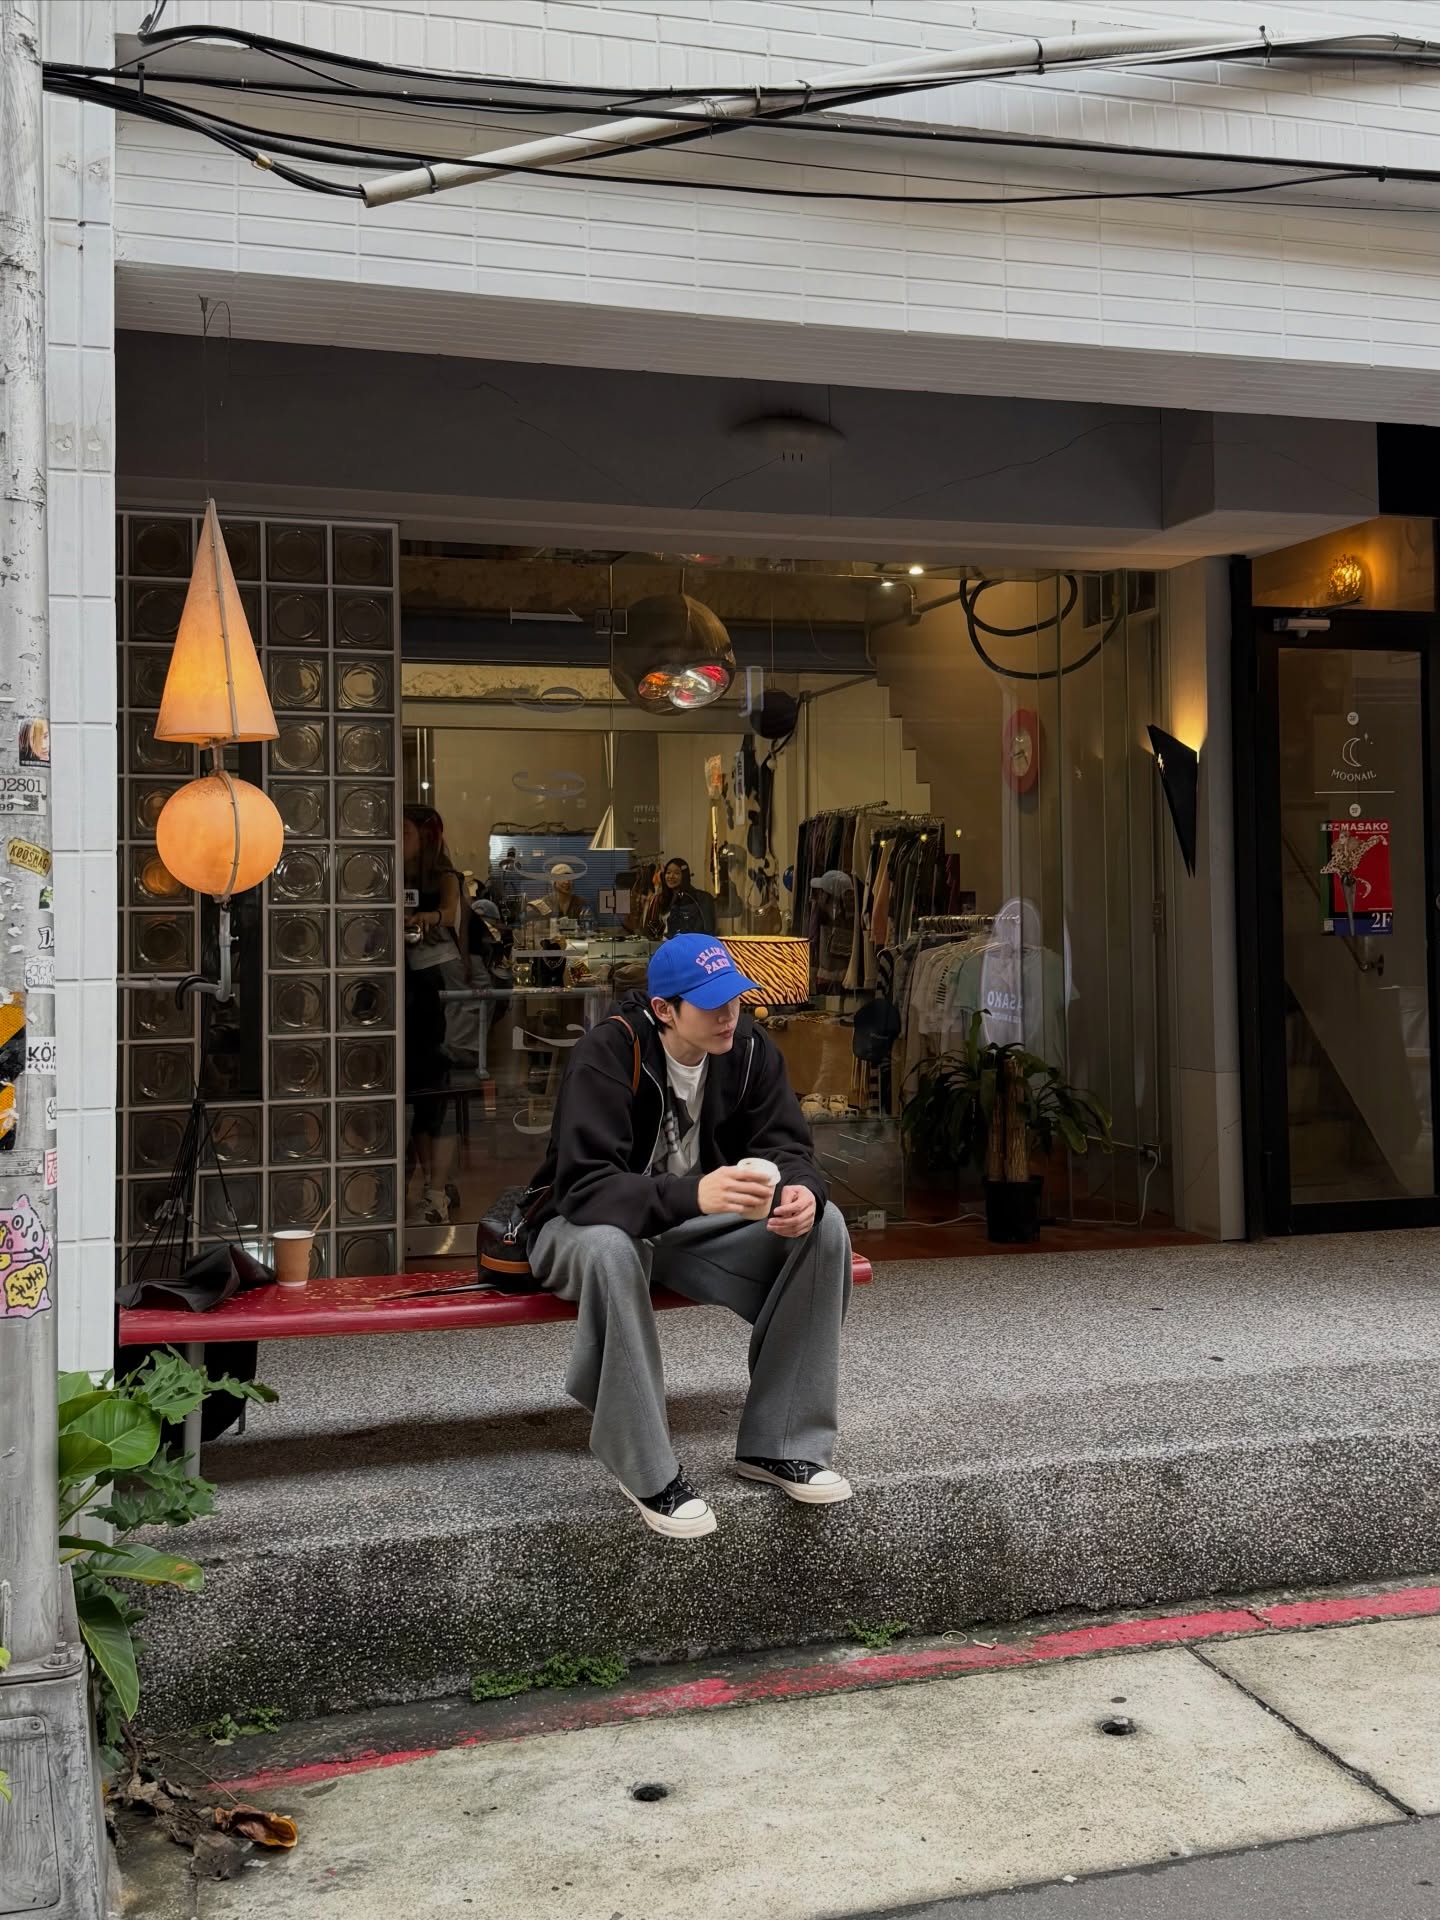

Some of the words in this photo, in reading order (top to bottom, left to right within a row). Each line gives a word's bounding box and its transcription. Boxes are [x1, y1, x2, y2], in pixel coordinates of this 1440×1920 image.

[1330, 768, 1377, 782] MOONAIL
[1340, 822, 1389, 831] MASAKO
[1371, 912, 1393, 928] 2F
